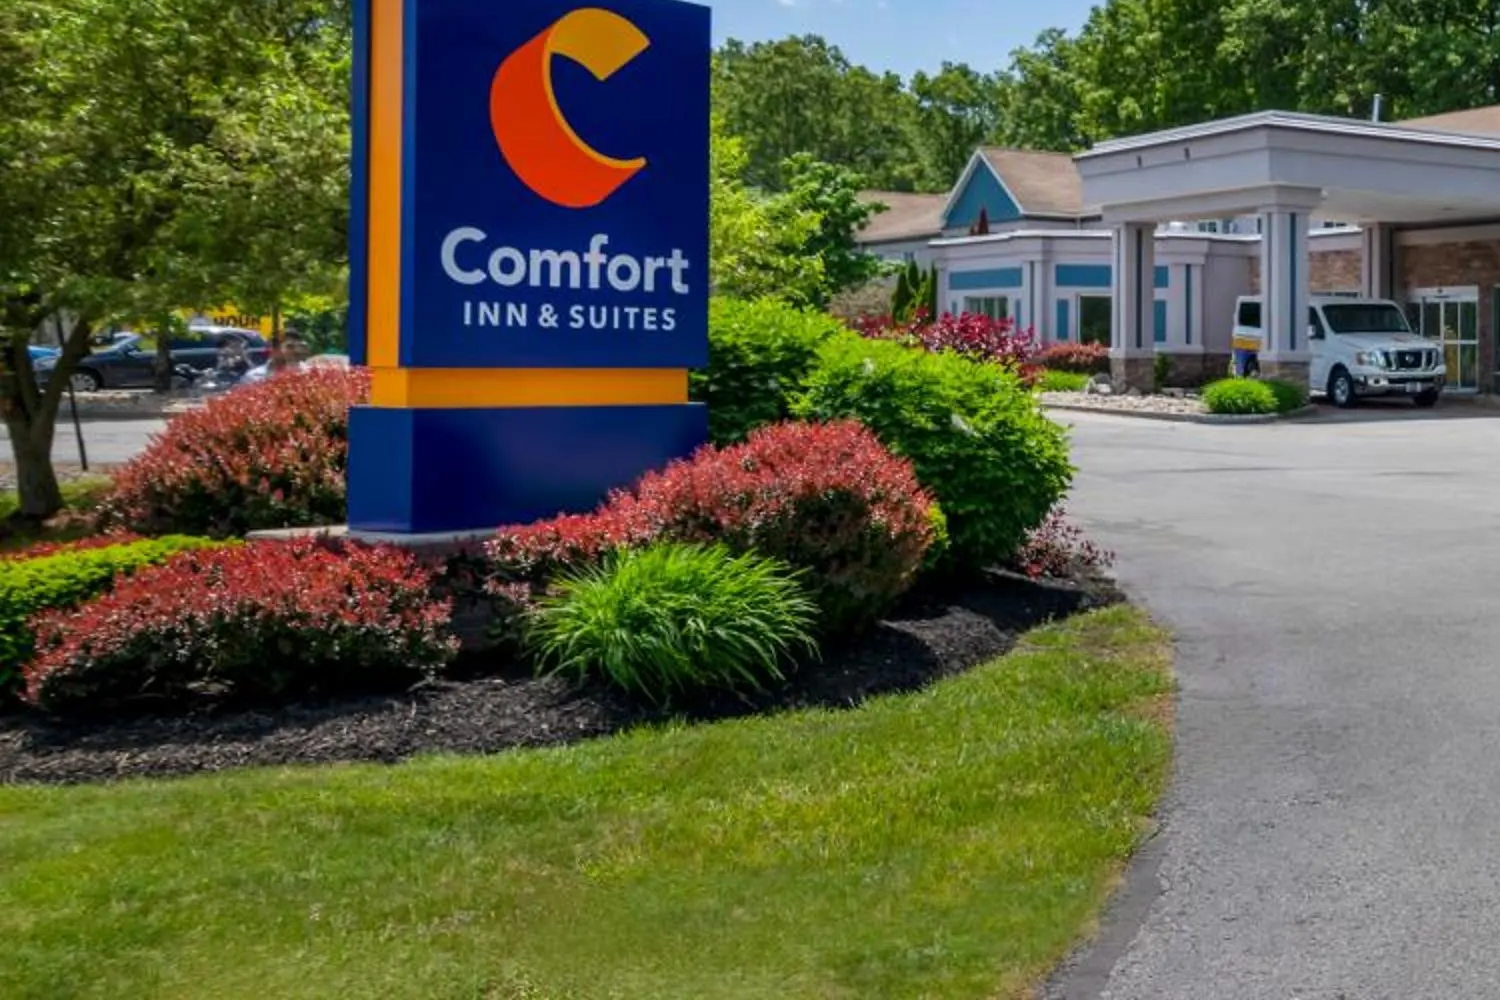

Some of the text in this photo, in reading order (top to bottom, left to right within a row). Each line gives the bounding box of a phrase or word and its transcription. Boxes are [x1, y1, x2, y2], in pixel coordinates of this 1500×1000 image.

[440, 226, 690, 294] Comfort
[463, 301, 677, 331] INN & SUITES
